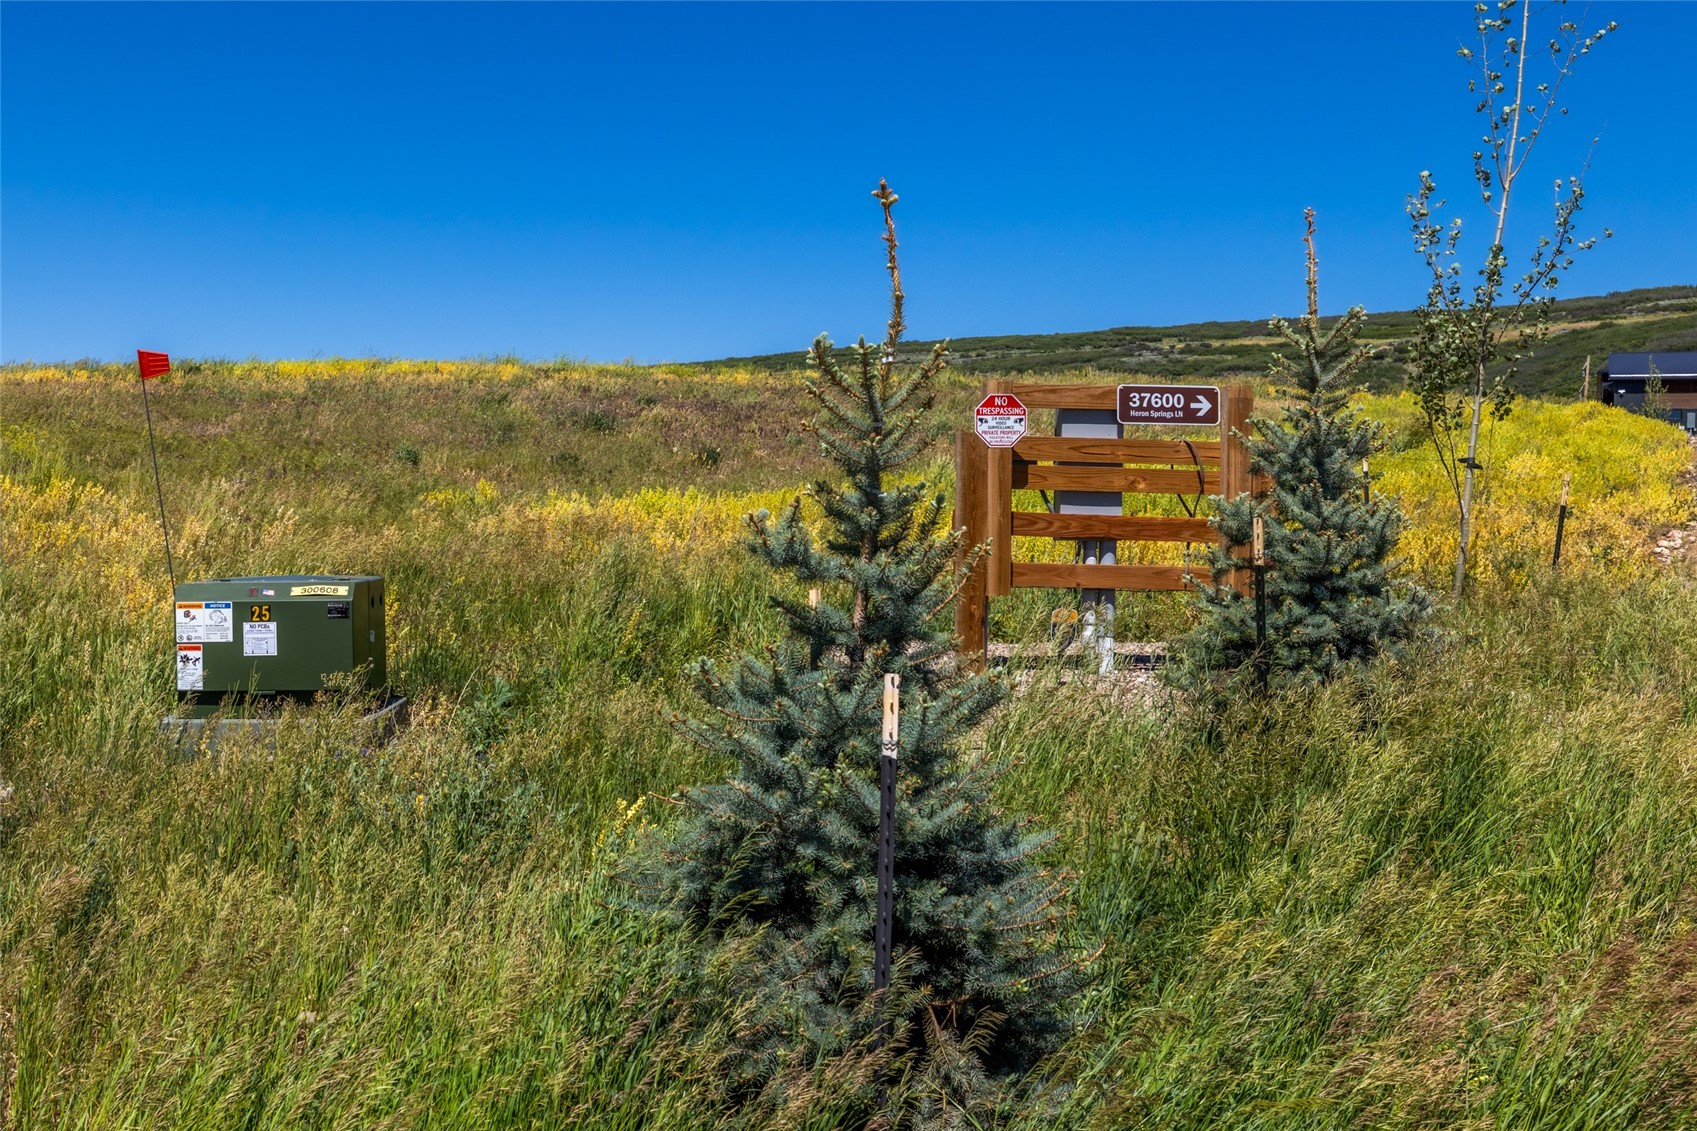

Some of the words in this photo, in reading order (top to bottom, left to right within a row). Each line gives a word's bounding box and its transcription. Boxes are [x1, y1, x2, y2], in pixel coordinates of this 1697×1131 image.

[994, 396, 1008, 406] NO
[1129, 392, 1185, 409] 37600
[979, 407, 1024, 415] TRESPASSING
[1130, 409, 1150, 417] Heron
[1150, 410, 1174, 418] Springs
[251, 605, 270, 622] 25
